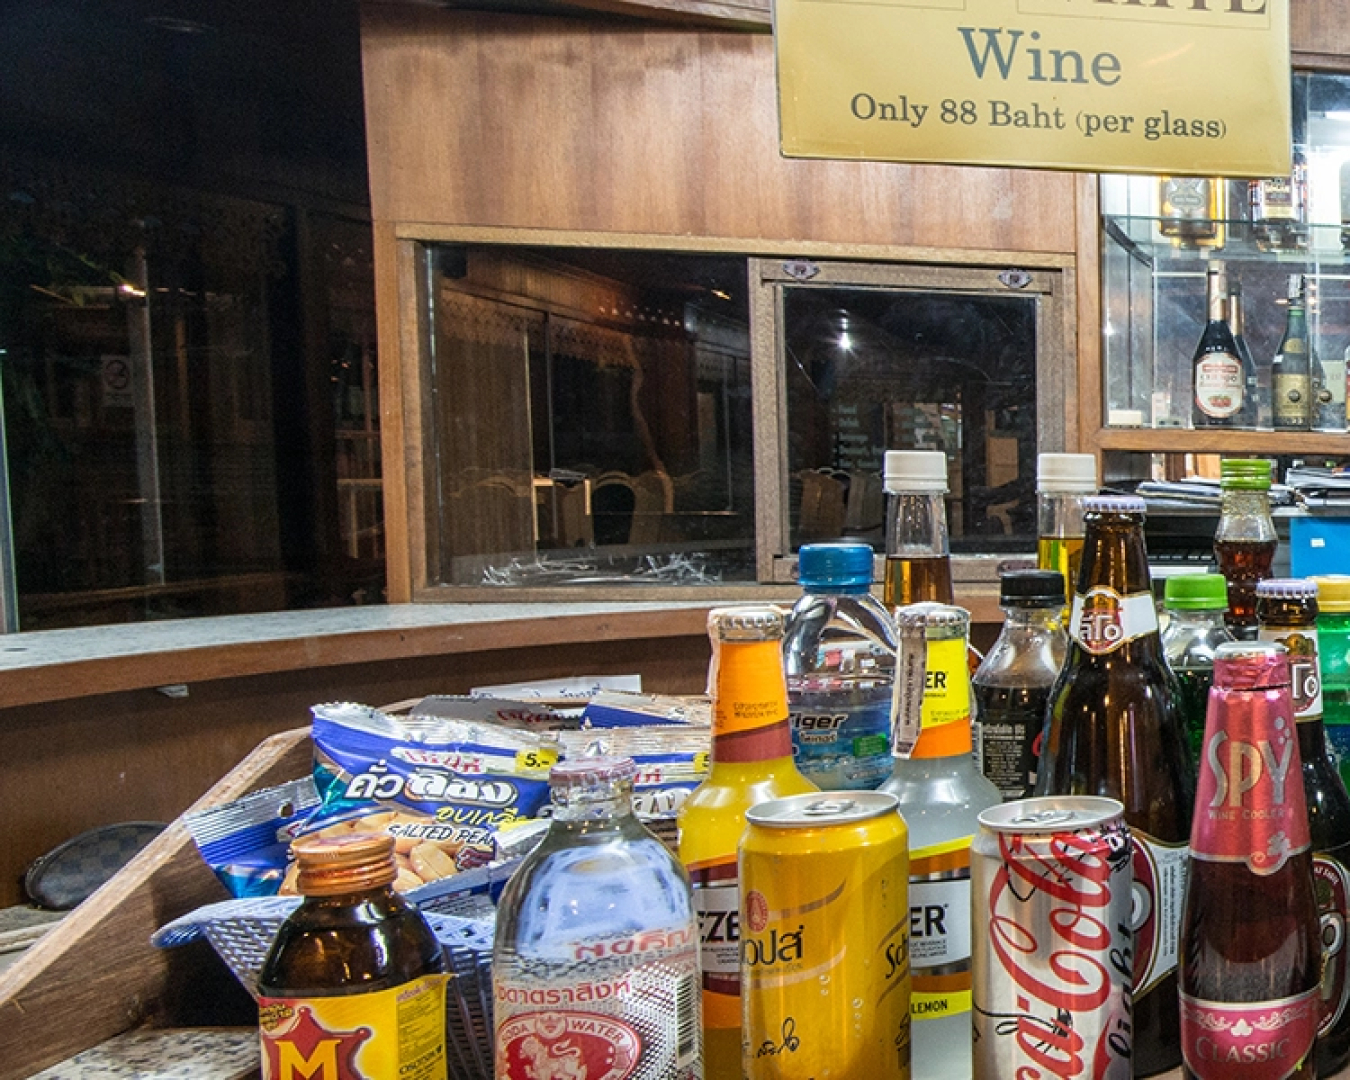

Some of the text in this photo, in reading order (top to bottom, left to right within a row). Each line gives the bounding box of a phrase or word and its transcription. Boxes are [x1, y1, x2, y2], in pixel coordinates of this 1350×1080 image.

[957, 26, 1122, 86] Wine
[850, 93, 1228, 140] Only 88 Baht (per glass)
[925, 671, 947, 689] ER
[1207, 730, 1294, 808] SPY
[1209, 809, 1285, 820] WINE COOLER
[387, 823, 453, 842] SALTED
[911, 904, 946, 936] ER
[911, 999, 948, 1014] LEMON
[571, 1017, 626, 1044] WATER
[275, 1039, 343, 1080] M
[1195, 1036, 1291, 1064] CLASSIC
